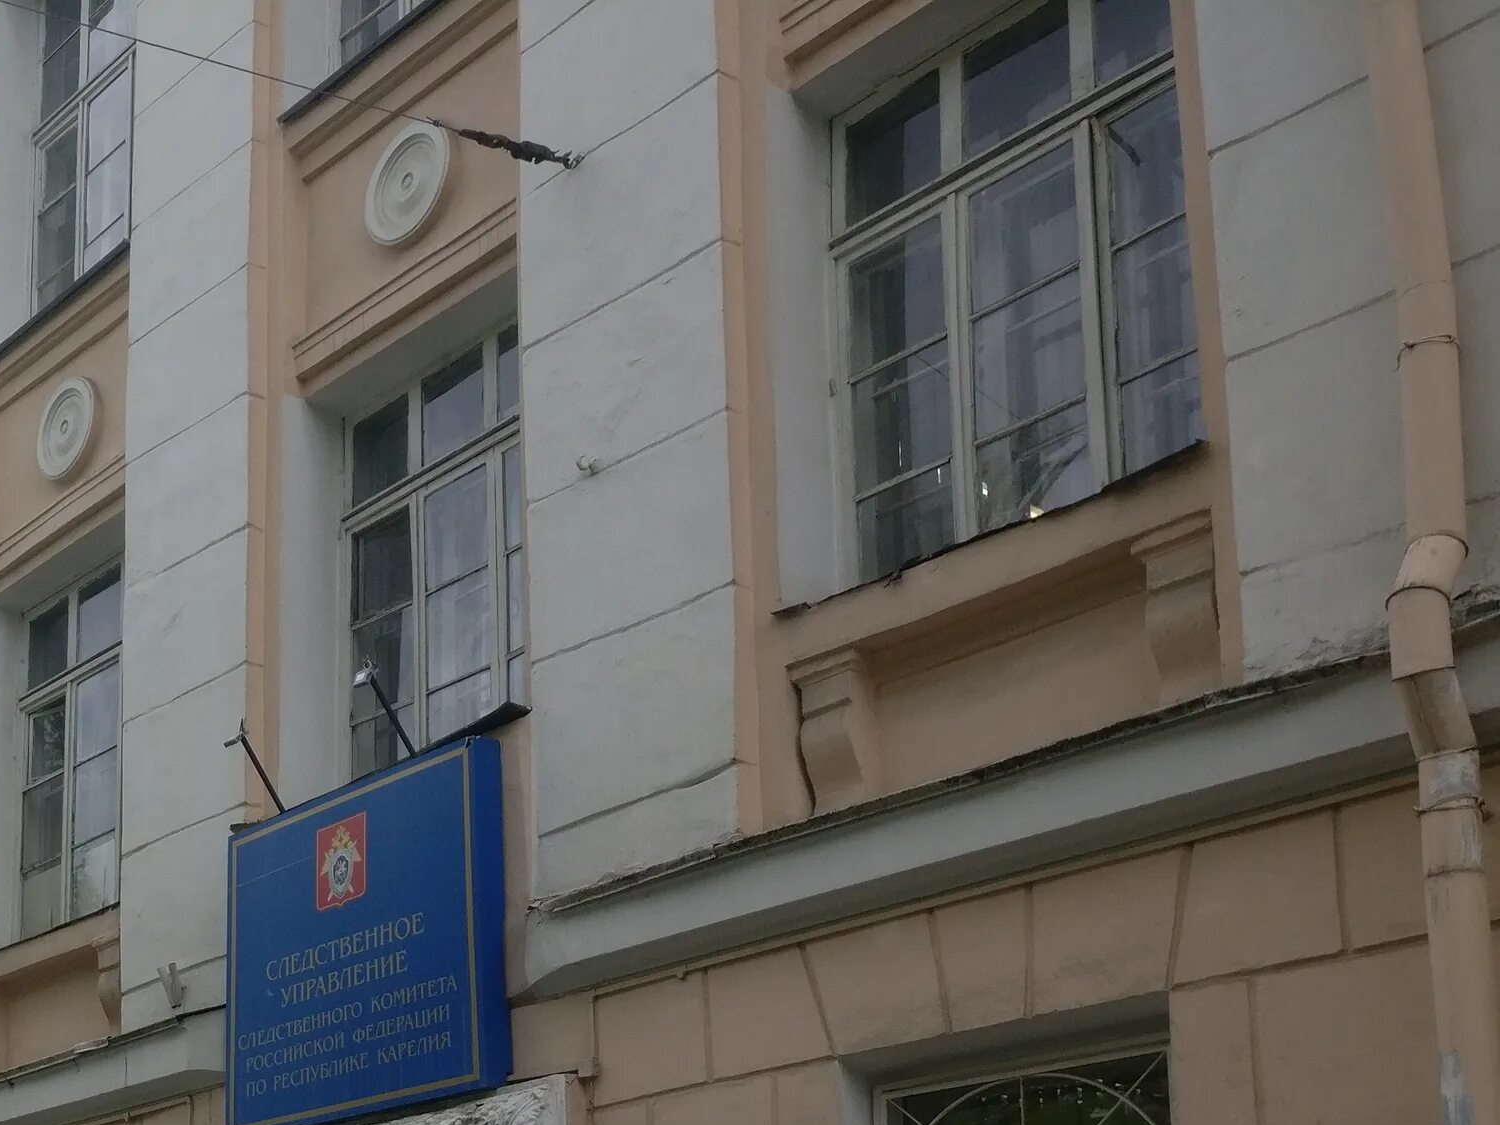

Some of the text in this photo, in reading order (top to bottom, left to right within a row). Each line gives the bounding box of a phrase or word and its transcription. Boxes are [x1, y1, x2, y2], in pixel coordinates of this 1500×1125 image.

[266, 912, 425, 982] СЛЕДСТВЕННОЕ
[280, 950, 408, 1009] УПРАВЛЕНИЕ
[238, 975, 458, 1051] СЛЕДСТВЕННОГО КОМИТЕТА
[246, 1003, 450, 1072] РОССИЙСКОЙ ФЕДЕРАЦИИ
[246, 1031, 451, 1098] ПО РЕСПУБЛИКЕ КАРЕЛИЯ
